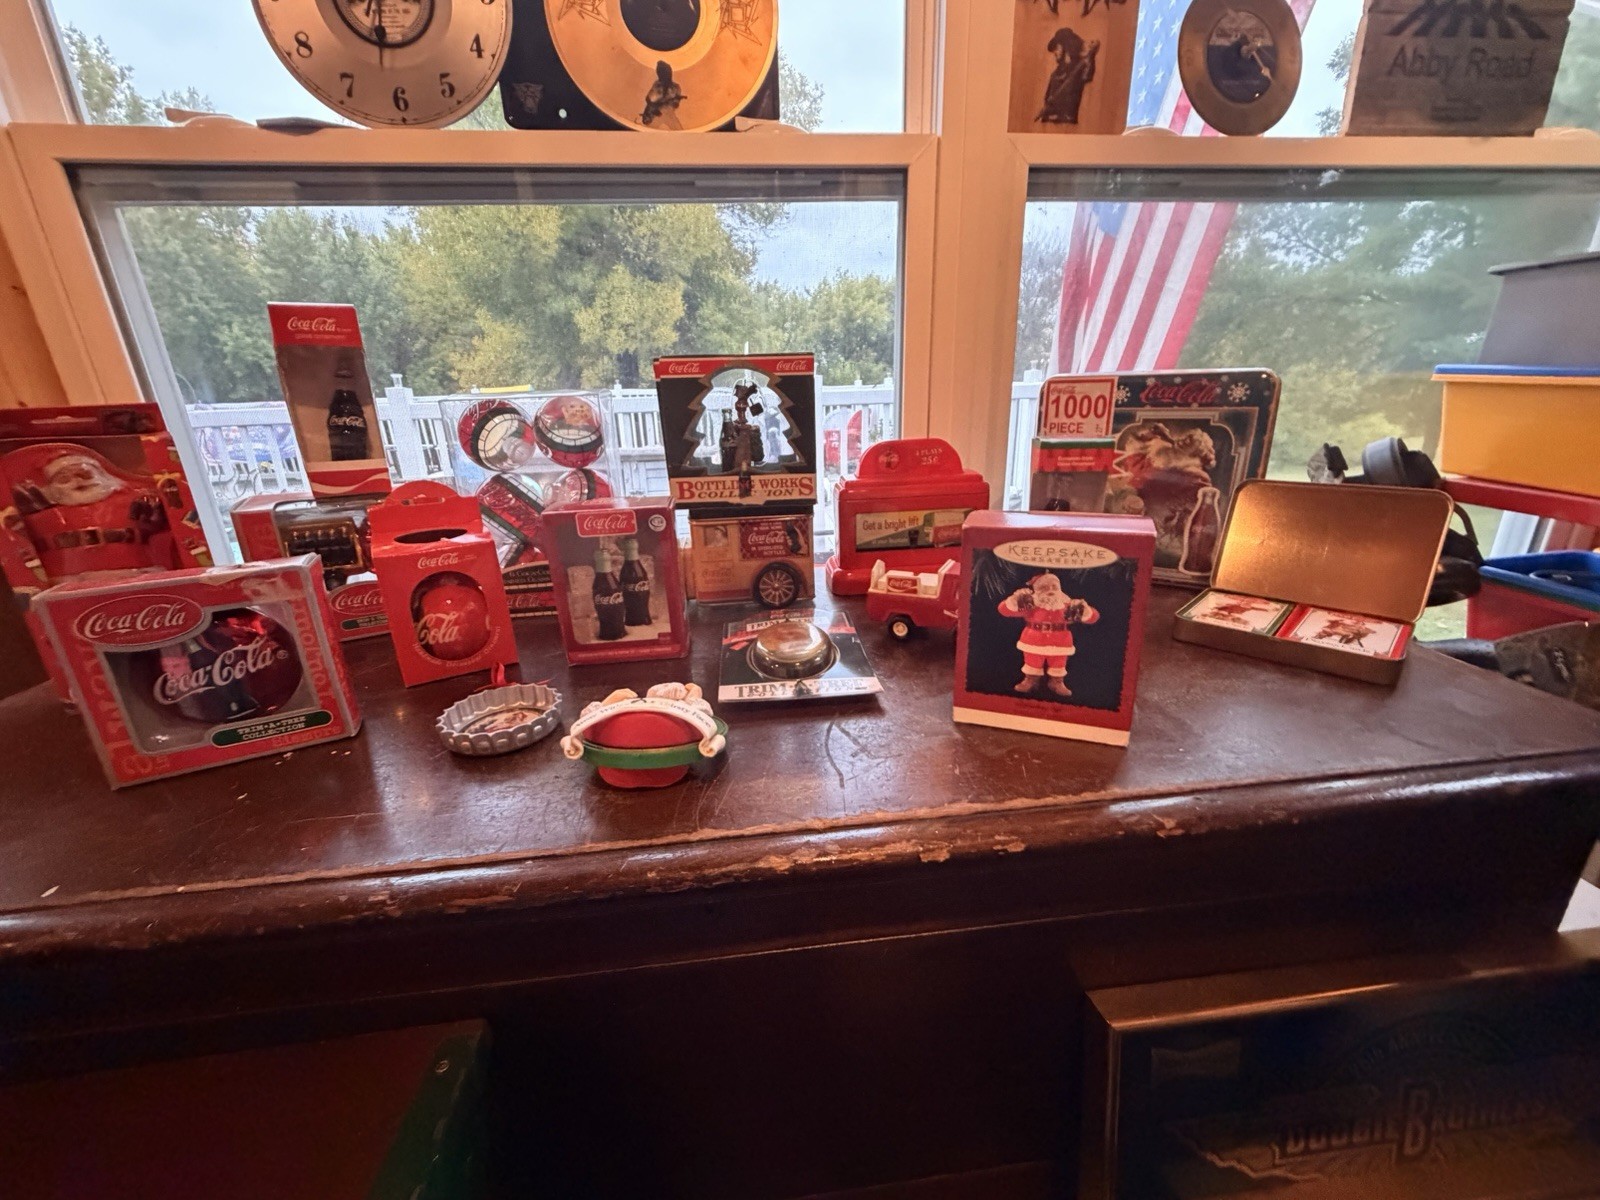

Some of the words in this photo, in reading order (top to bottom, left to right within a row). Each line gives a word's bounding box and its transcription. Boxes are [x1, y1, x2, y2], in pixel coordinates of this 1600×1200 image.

[294, 31, 314, 59] 8
[469, 33, 485, 58] 4
[339, 73, 356, 97] 7
[438, 73, 455, 98] 5
[392, 86, 410, 112] 6
[287, 316, 337, 332] Coca-Cola
[668, 362, 700, 374] Coca-Cola
[776, 360, 807, 371] Coca-Cola
[1051, 394, 1107, 419] 1000
[1048, 422, 1085, 434] PIECE
[758, 477, 814, 496] WORKS
[583, 514, 628, 531] Coca-Cola
[863, 520, 876, 531] Get
[877, 521, 883, 530] a
[884, 518, 907, 531] bright
[748, 530, 787, 545] Coca-Cola
[417, 552, 459, 569] Coca-Cola
[1008, 544, 1107, 560] KEEPSAKE
[1022, 555, 1086, 566] ORNAMENT
[83, 600, 188, 640] Coca-Cola
[153, 635, 276, 706] Coca-Cola
[242, 722, 306, 741] COLLECTION
